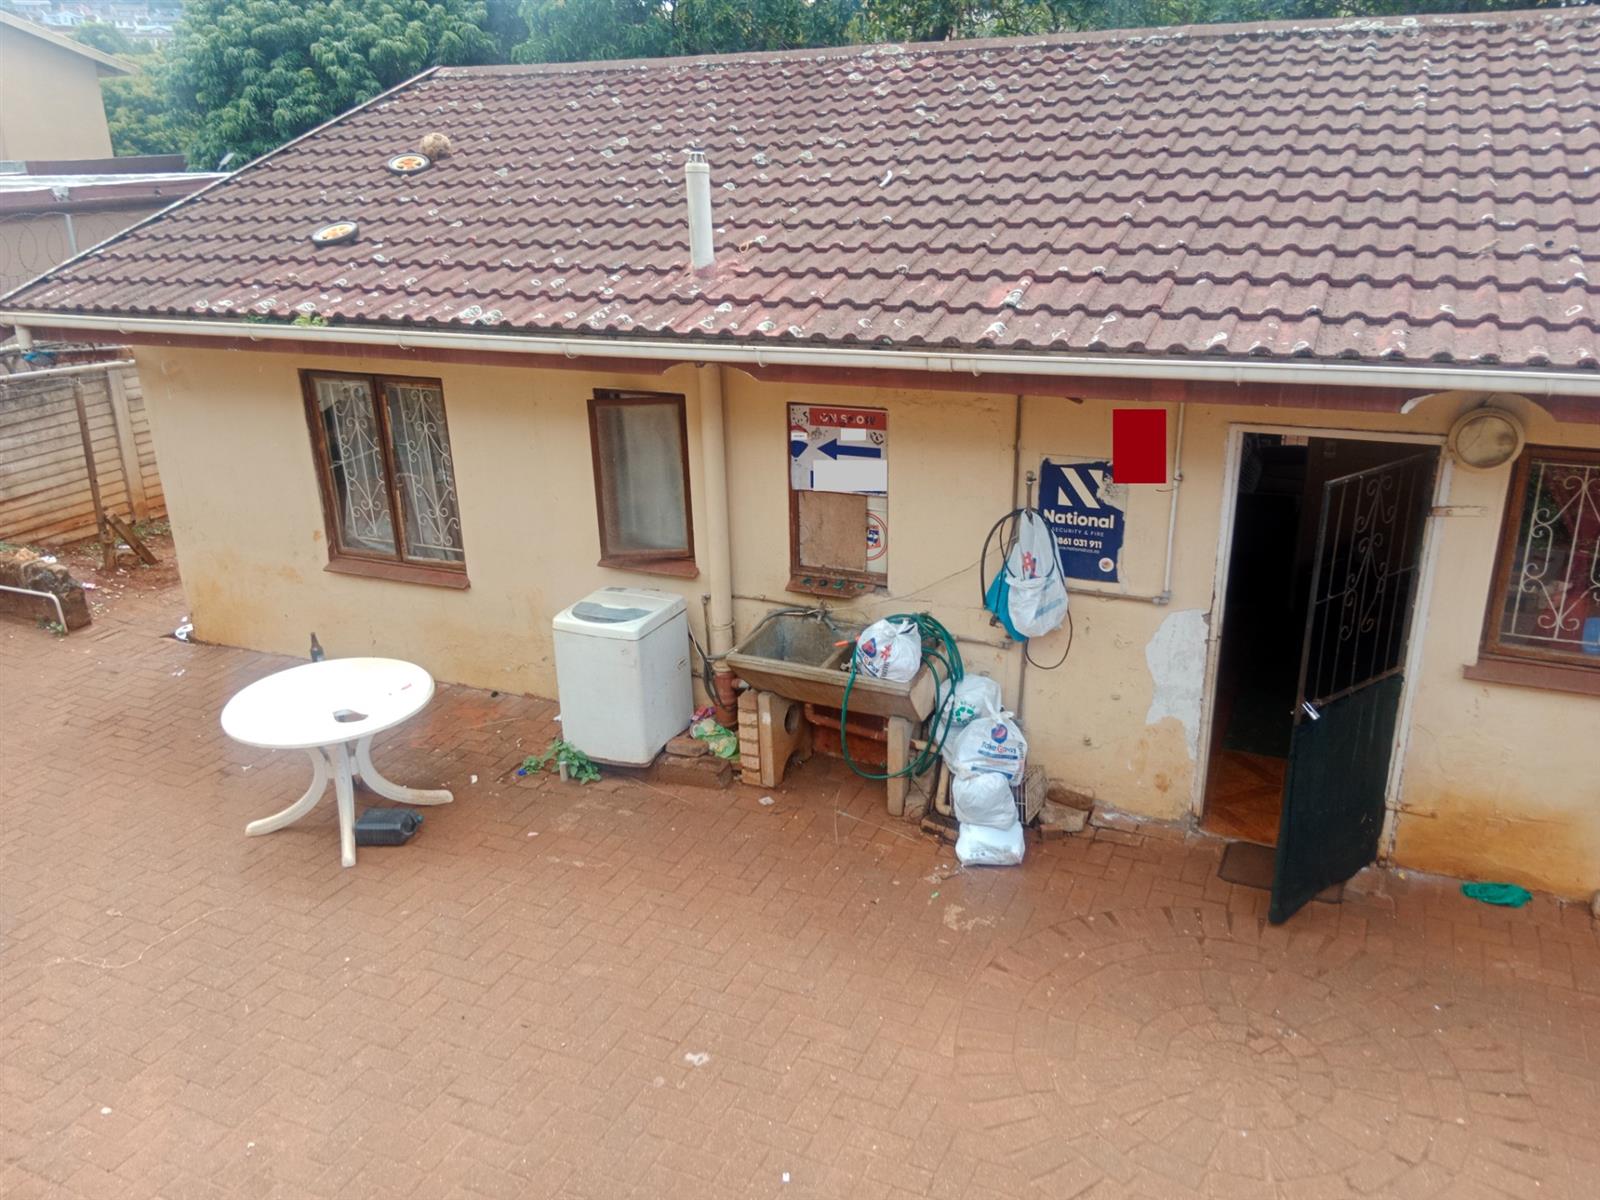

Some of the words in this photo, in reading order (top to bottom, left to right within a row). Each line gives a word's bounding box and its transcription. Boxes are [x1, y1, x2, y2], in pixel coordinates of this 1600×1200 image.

[1043, 509, 1114, 528] National
[1052, 526, 1082, 534] SECURITY
[1058, 537, 1072, 546] 861
[1073, 538, 1088, 548] 031
[1089, 540, 1102, 549] 911
